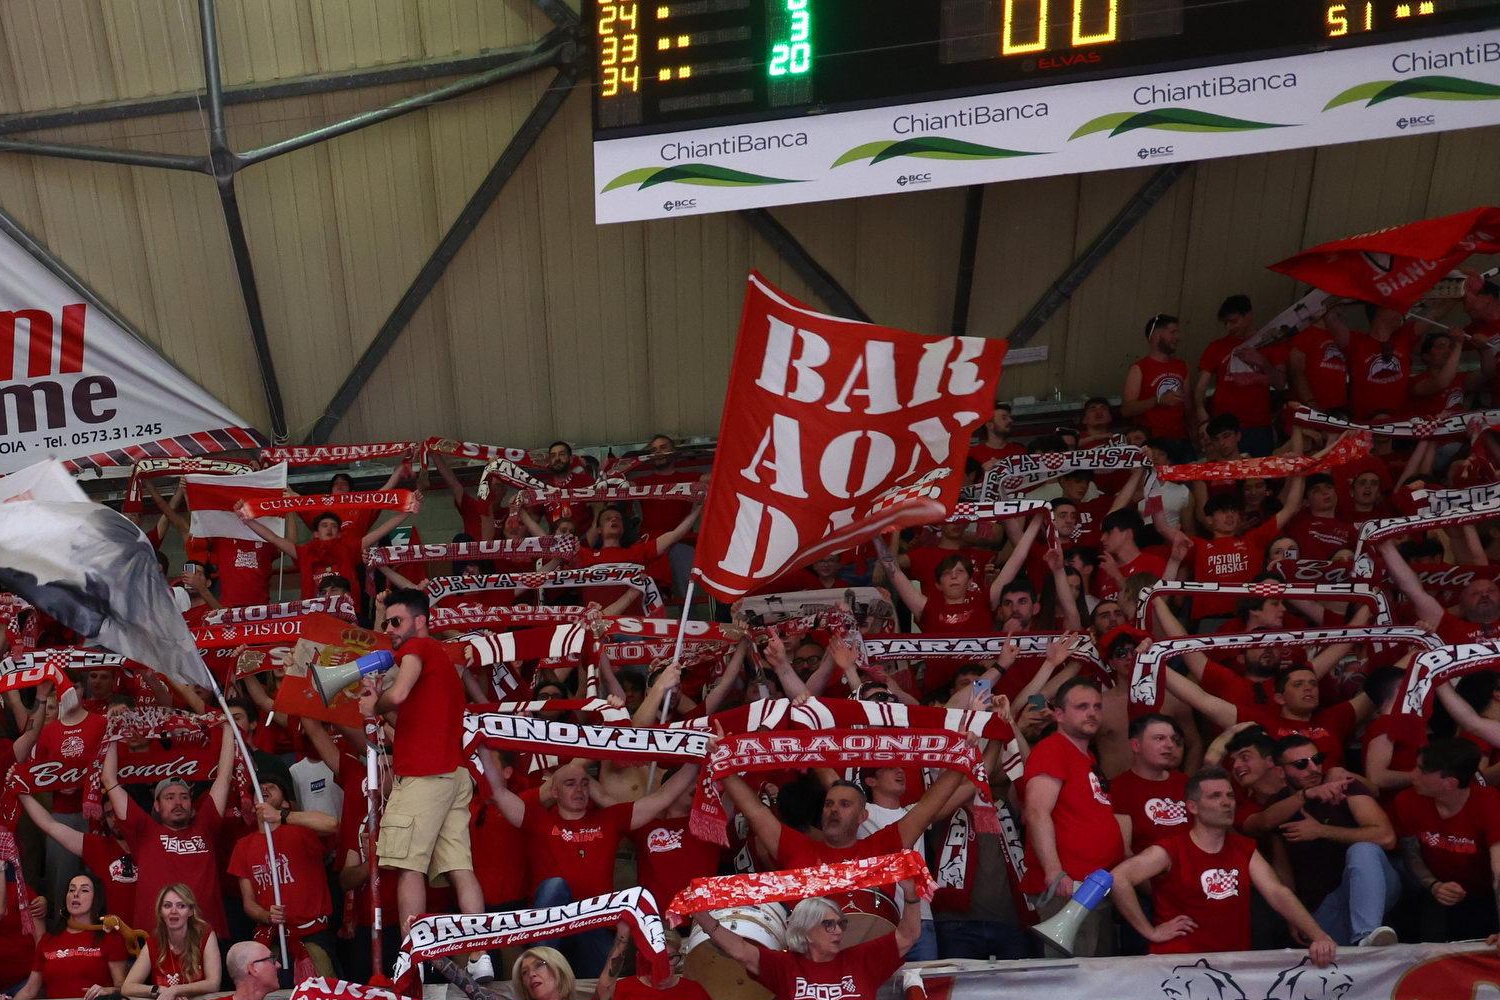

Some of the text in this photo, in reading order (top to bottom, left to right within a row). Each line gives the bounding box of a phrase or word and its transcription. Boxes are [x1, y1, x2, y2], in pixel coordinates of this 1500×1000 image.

[769, 43, 812, 76] 20
[602, 66, 639, 96] 34
[1133, 72, 1297, 105] ChiantiBanca
[893, 102, 1048, 134] ChiantiBanca
[1410, 115, 1435, 124] BCC
[661, 131, 808, 162] ChiantiBanca
[1150, 146, 1174, 155] BCC
[909, 173, 932, 182] BCC
[675, 199, 697, 208] BCC
[43, 433, 67, 450] Tel.
[71, 422, 162, 446] 0573.31.245
[260, 492, 400, 511] CURVA PISTOIA
[714, 750, 972, 771] CURVA PISTOIA
[411, 888, 644, 949] BARAONDA
[420, 941, 463, 958] Quindici
[466, 937, 489, 949] anni
[491, 934, 503, 945] di
[507, 929, 530, 946] folle
[533, 926, 567, 939] amore
